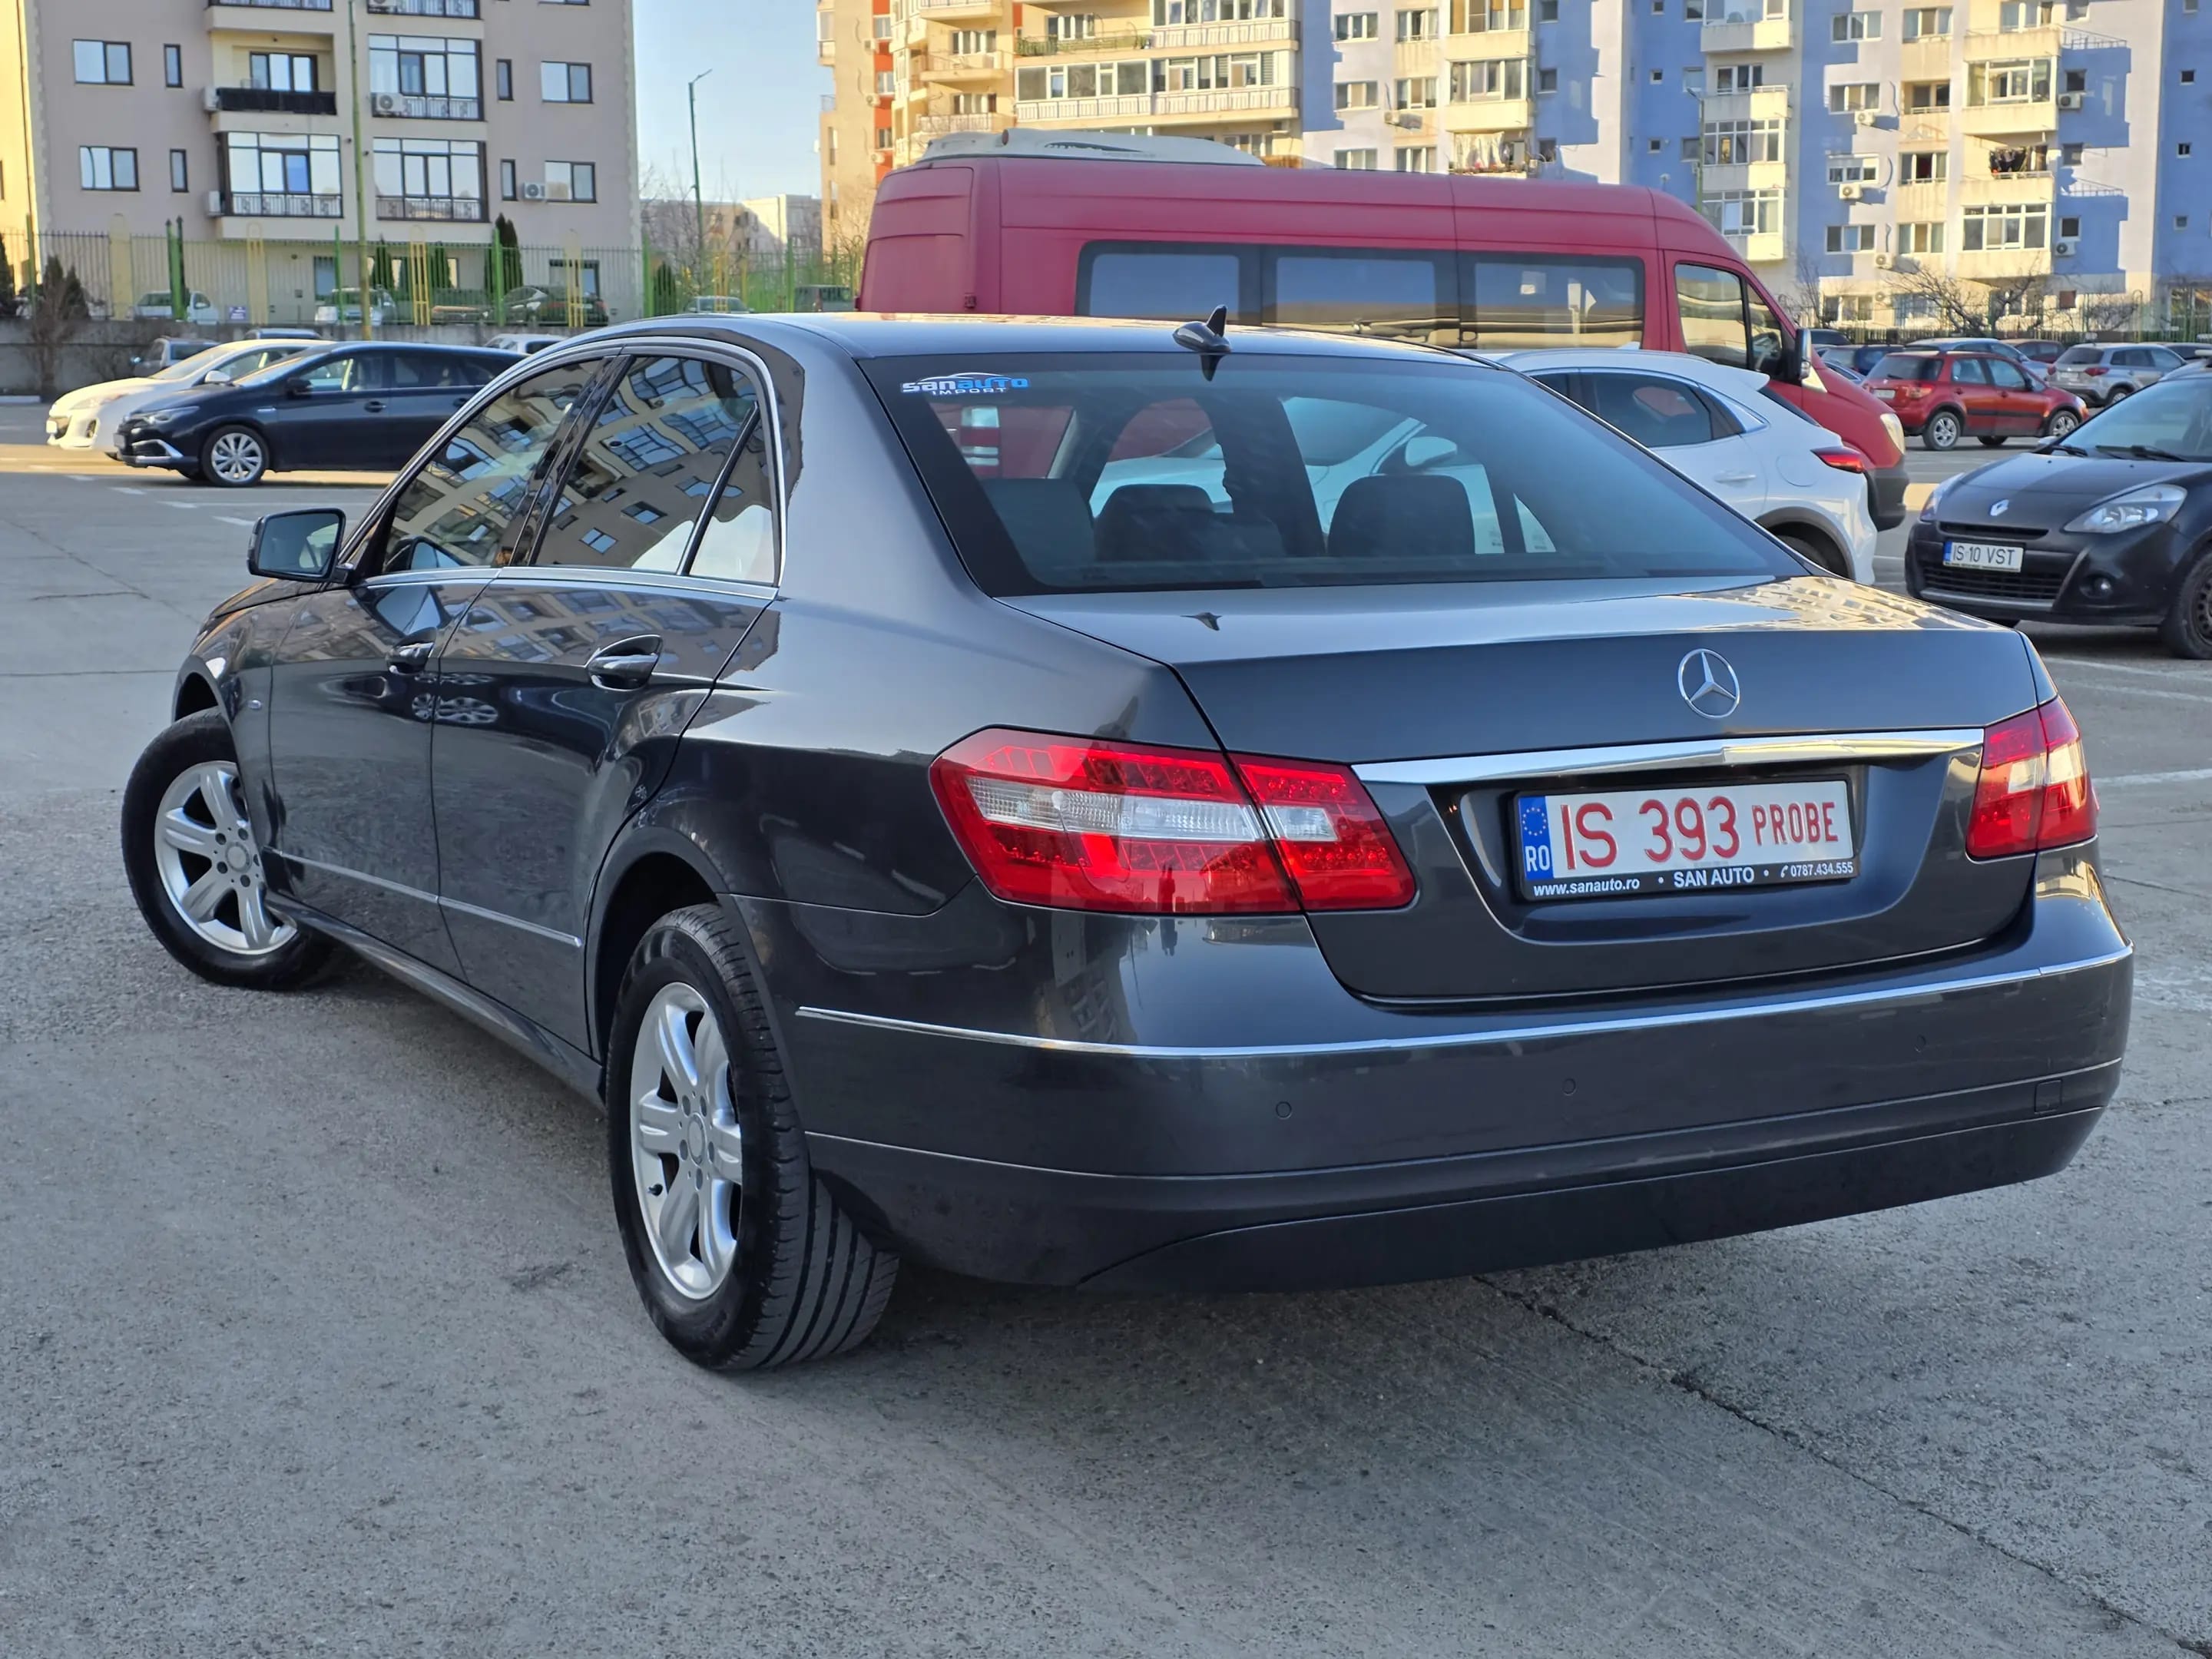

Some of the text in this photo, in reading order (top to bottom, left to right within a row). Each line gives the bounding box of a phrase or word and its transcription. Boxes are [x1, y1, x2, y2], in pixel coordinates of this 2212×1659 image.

[932, 387, 1007, 396] IMPORT
[1953, 545, 2015, 566] IS 10 VST
[1560, 796, 1839, 870] IS 393 PROBE
[1525, 845, 1551, 873] RO
[1533, 861, 1854, 897] www.sanauto.ro SAN AUTO 0787.434.555
